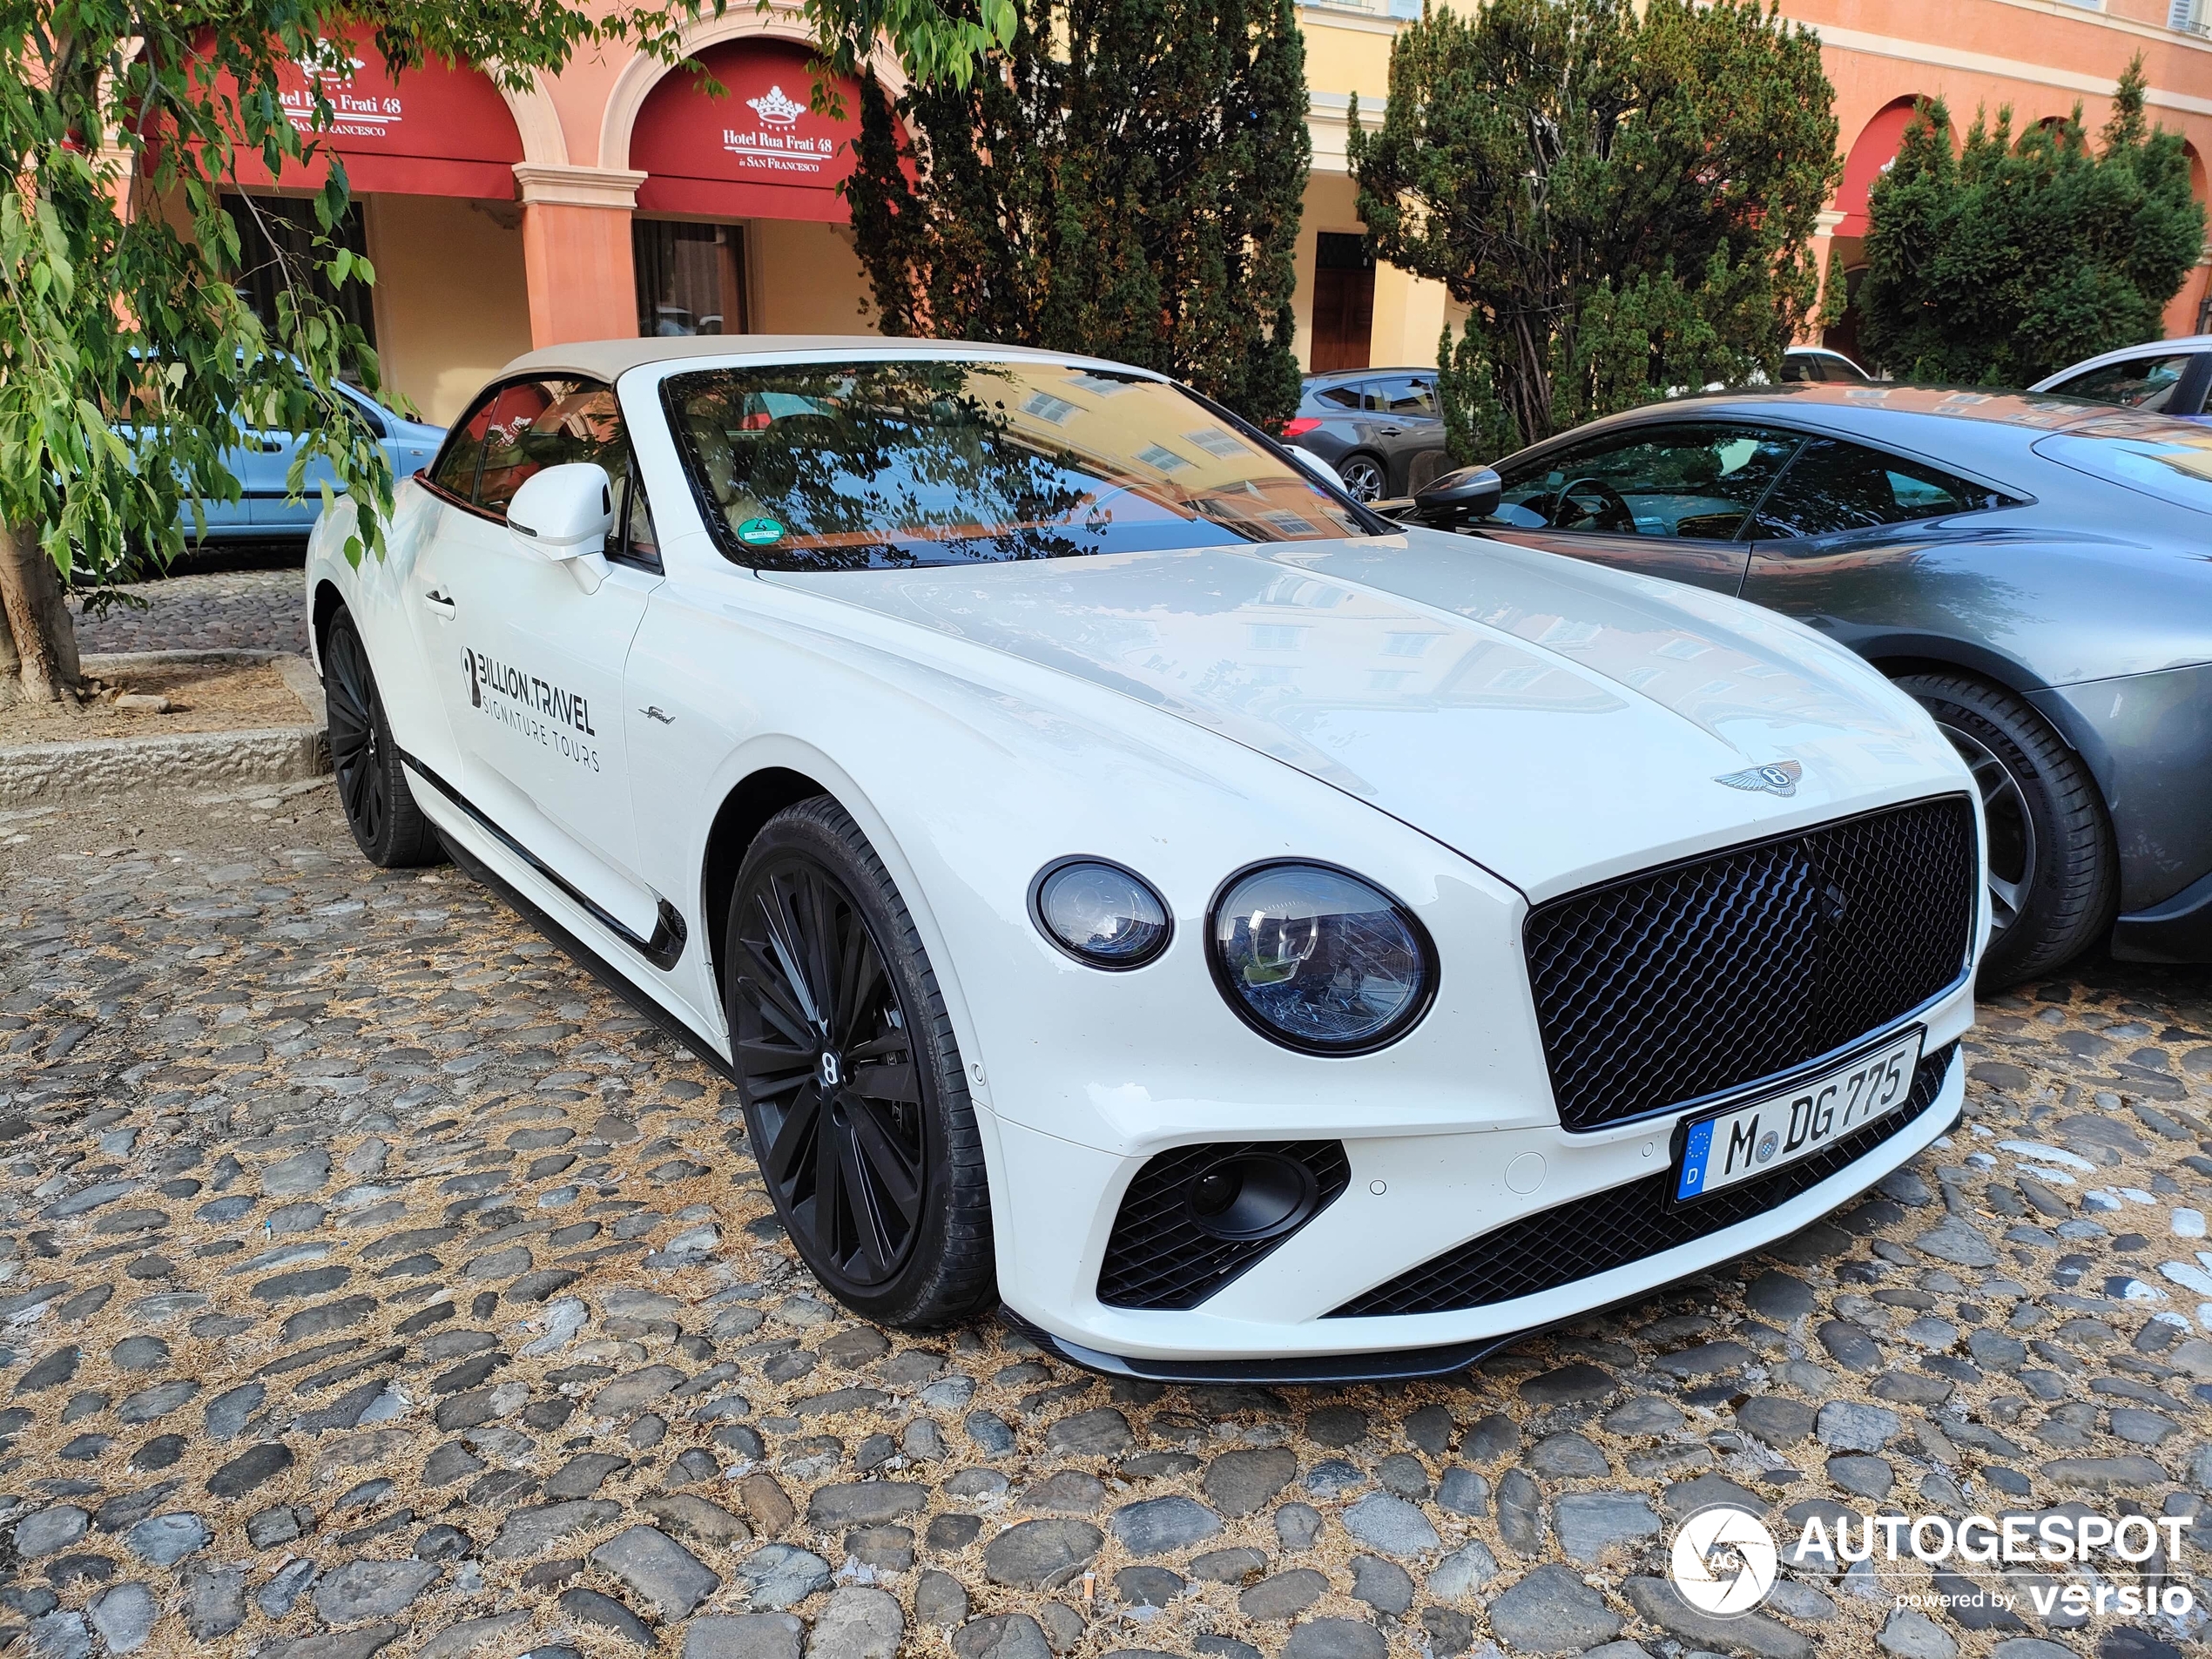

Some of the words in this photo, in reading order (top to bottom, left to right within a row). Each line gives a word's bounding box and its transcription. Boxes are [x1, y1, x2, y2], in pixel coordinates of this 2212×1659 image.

[278, 90, 301, 106] tel
[304, 91, 337, 110] Ra
[340, 94, 378, 112] Frati
[382, 98, 401, 114] 48
[289, 118, 314, 132] SAN
[723, 130, 756, 145] Hotel
[759, 132, 783, 148] Rua
[786, 134, 814, 152] Frati
[818, 138, 833, 152] 48
[746, 156, 765, 168] SAN
[768, 158, 819, 172] FRANCESCO
[477, 652, 596, 737] BILLION.TRAVEL
[637, 705, 676, 725] Speed
[482, 695, 549, 745] SIGNATURE
[552, 731, 600, 773] TOURS
[1941, 701, 2036, 775] MICHELIN
[1723, 1113, 1759, 1175] M
[1782, 1084, 1838, 1155] DG
[1841, 1049, 1906, 1127] 775
[1686, 1168, 1698, 1185] D
